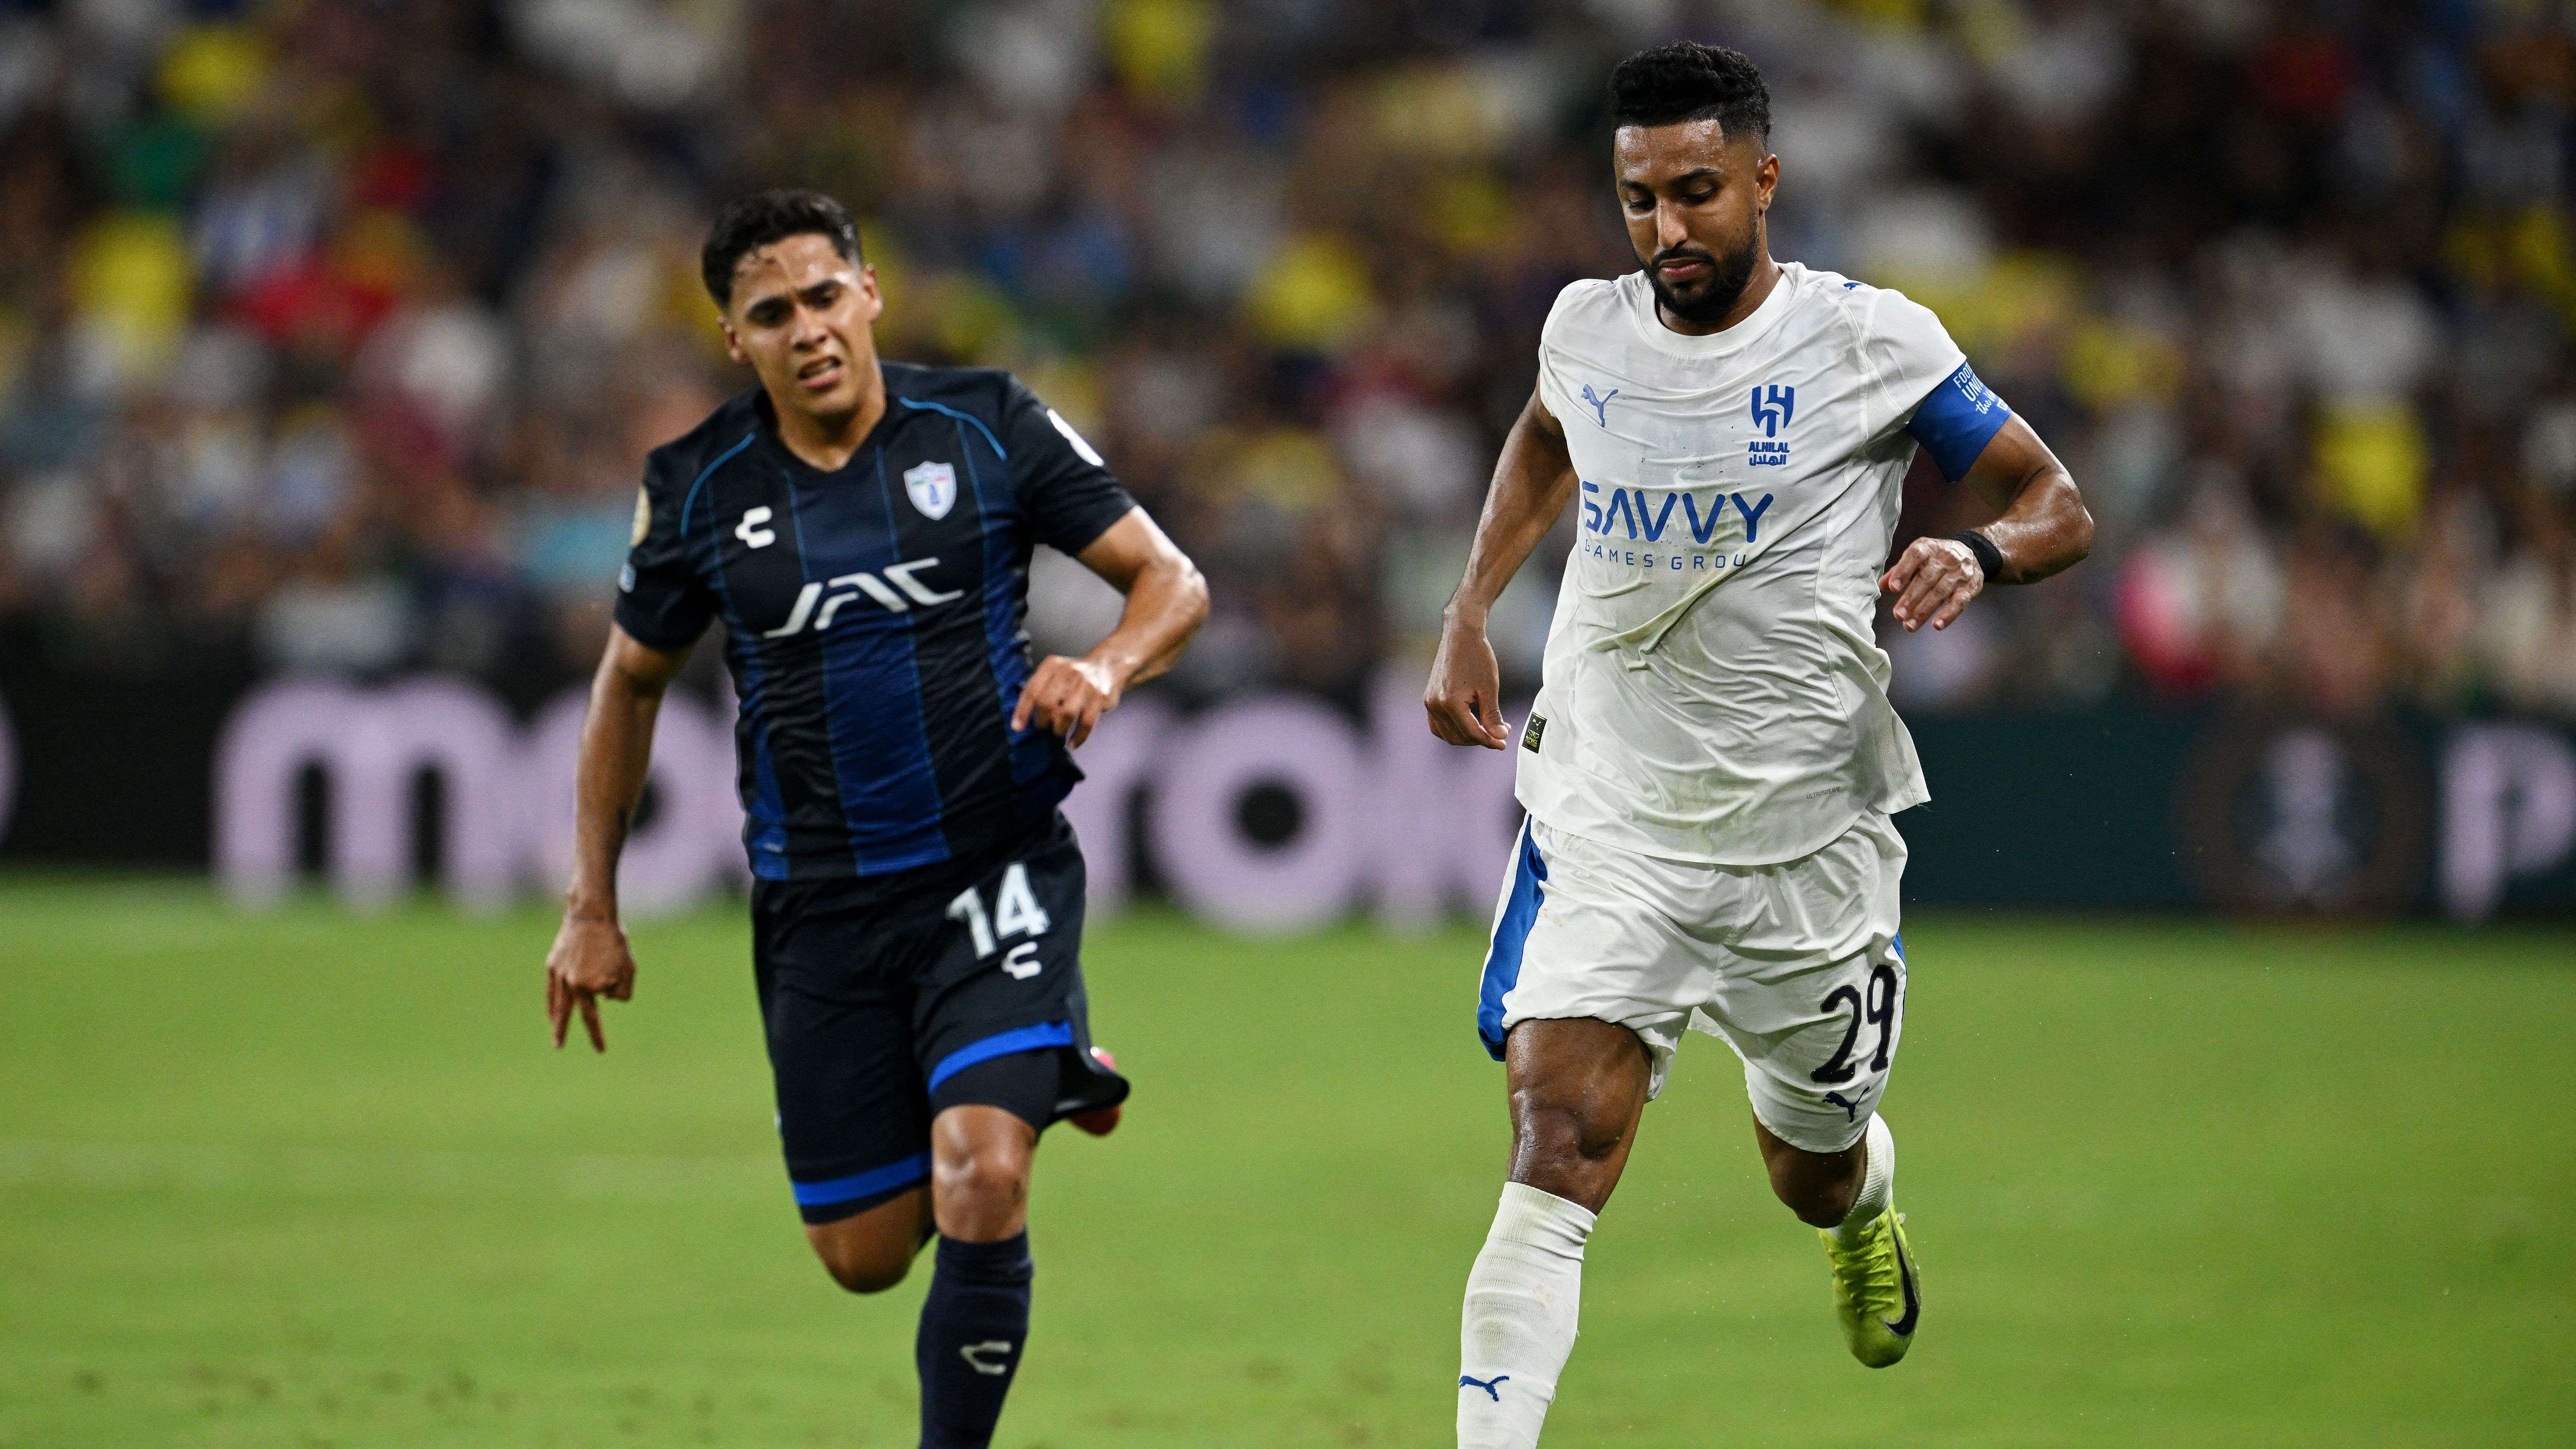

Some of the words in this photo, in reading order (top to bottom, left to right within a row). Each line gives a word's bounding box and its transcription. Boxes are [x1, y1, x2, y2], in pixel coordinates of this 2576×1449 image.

[1976, 400, 1992, 414] the
[1748, 441, 1790, 453] ALHILAL
[1749, 454, 1787, 466] الهلال
[1581, 480, 1774, 544] SAVVY
[1585, 538, 1653, 568] GAMES
[1670, 554, 1746, 570] GROU
[762, 557, 965, 638] JAC
[945, 860, 1051, 960] 14
[1809, 964, 1898, 1084] 29
